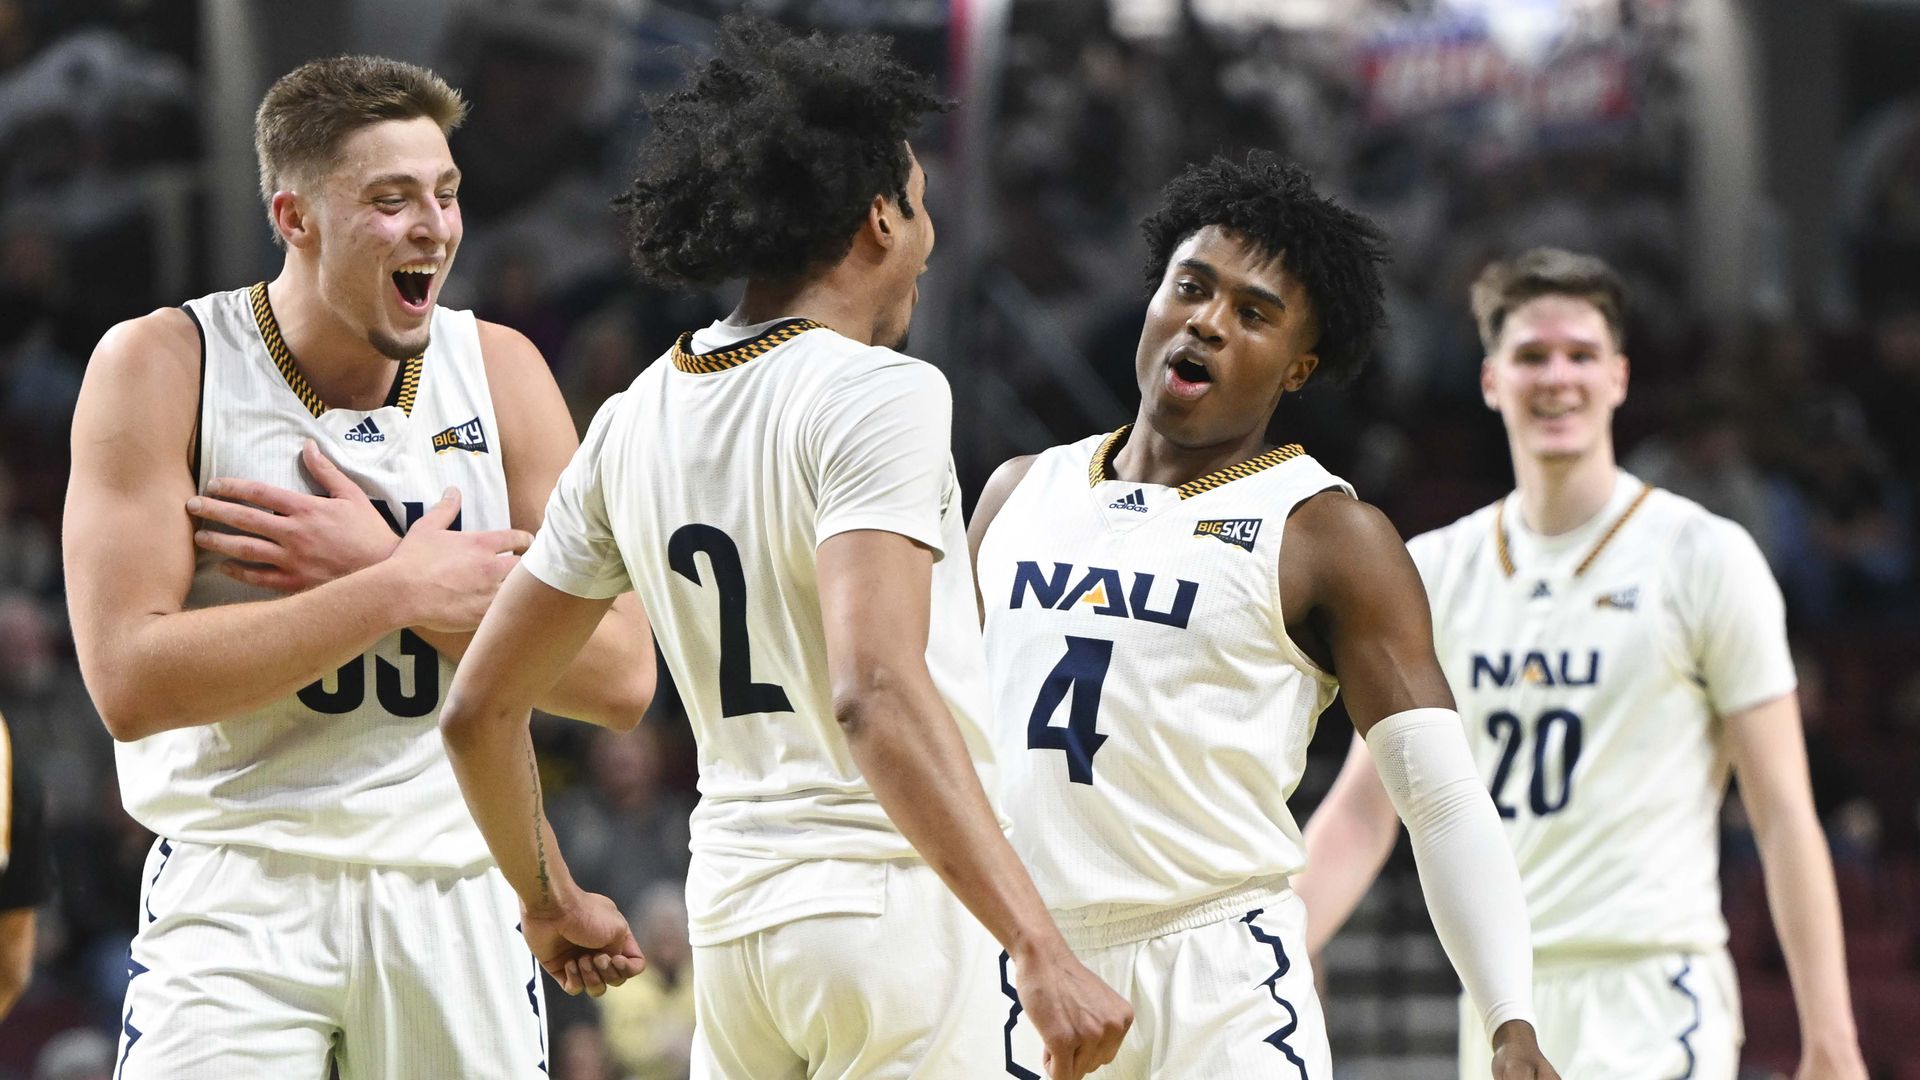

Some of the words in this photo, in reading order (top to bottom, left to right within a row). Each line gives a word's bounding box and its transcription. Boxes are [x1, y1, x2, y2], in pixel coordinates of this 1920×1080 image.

[344, 431, 385, 443] adidas
[1109, 501, 1149, 513] adidas
[667, 523, 796, 718] 2
[1009, 561, 1200, 629] NAU
[1471, 650, 1600, 689] NAU
[1027, 635, 1114, 785] 4
[1486, 709, 1584, 819] 20
